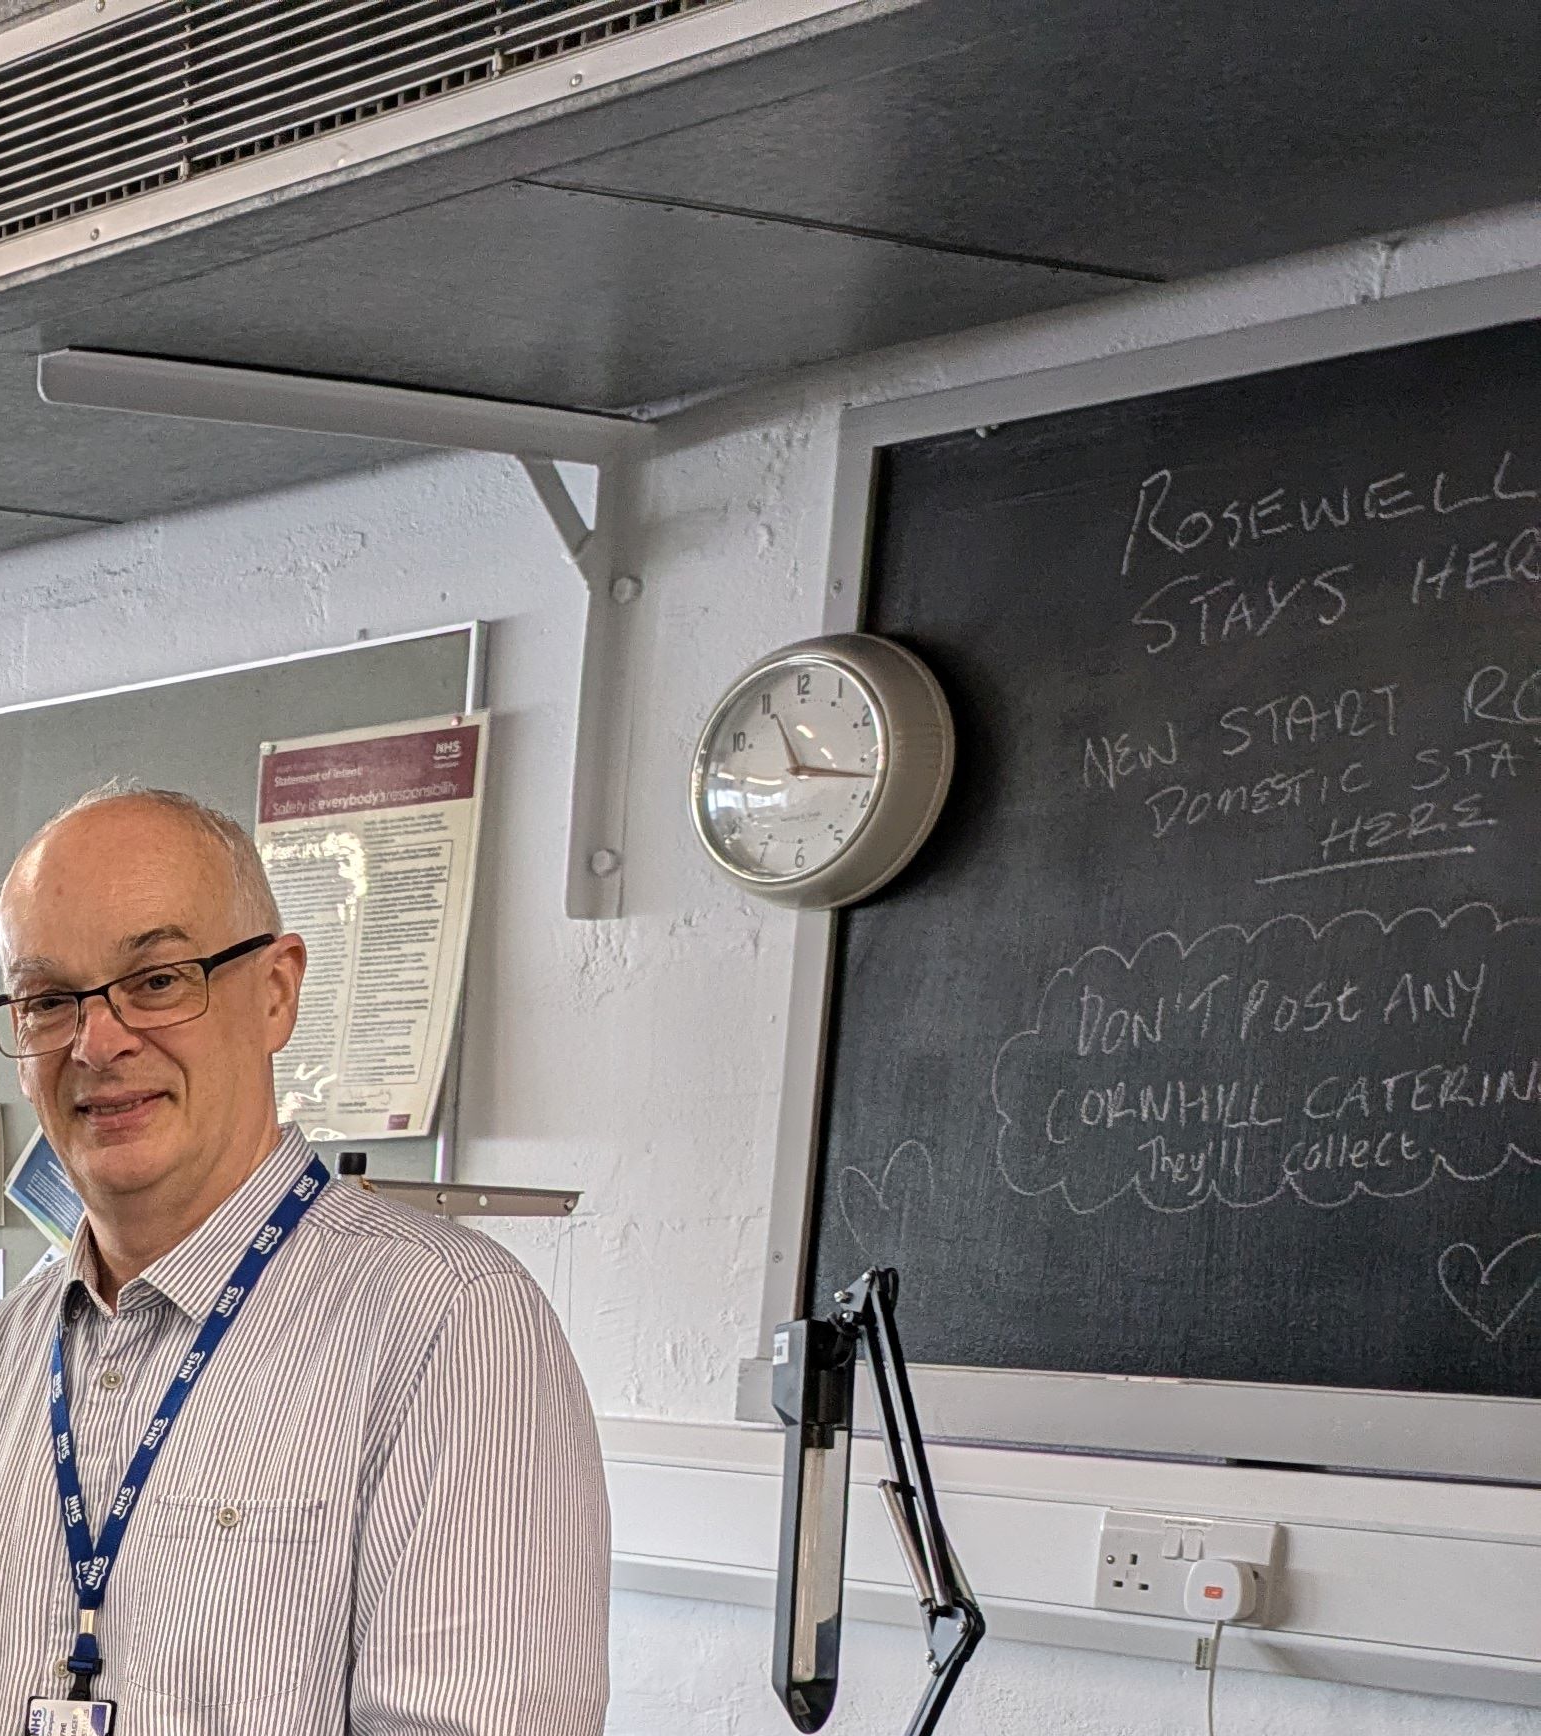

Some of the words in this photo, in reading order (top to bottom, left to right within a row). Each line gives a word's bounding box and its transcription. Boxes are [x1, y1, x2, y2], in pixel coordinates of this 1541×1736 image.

[1132, 563, 1354, 654] STAYS
[797, 674, 811, 696] 12
[436, 740, 461, 754] NHS
[732, 732, 746, 752] 10
[1083, 720, 1177, 790] NEW
[1219, 683, 1400, 757] START
[1145, 761, 1373, 840] DOMESTIC
[1318, 793, 1499, 862] HERE
[794, 847, 806, 869] 6
[1077, 974, 1230, 1057] DON'T
[1383, 963, 1487, 1045] ANY
[1046, 1079, 1284, 1145] CORNHILL
[1303, 1059, 1541, 1121] CATERIN
[293, 1174, 314, 1198] NHS
[253, 1224, 277, 1251] NHS
[216, 1285, 239, 1314] NHS
[179, 1351, 201, 1379] NHS
[143, 1418, 164, 1447] NHS
[67, 1494, 83, 1523] NHS
[112, 1486, 131, 1516] NHS
[86, 1556, 104, 1586] NHS
